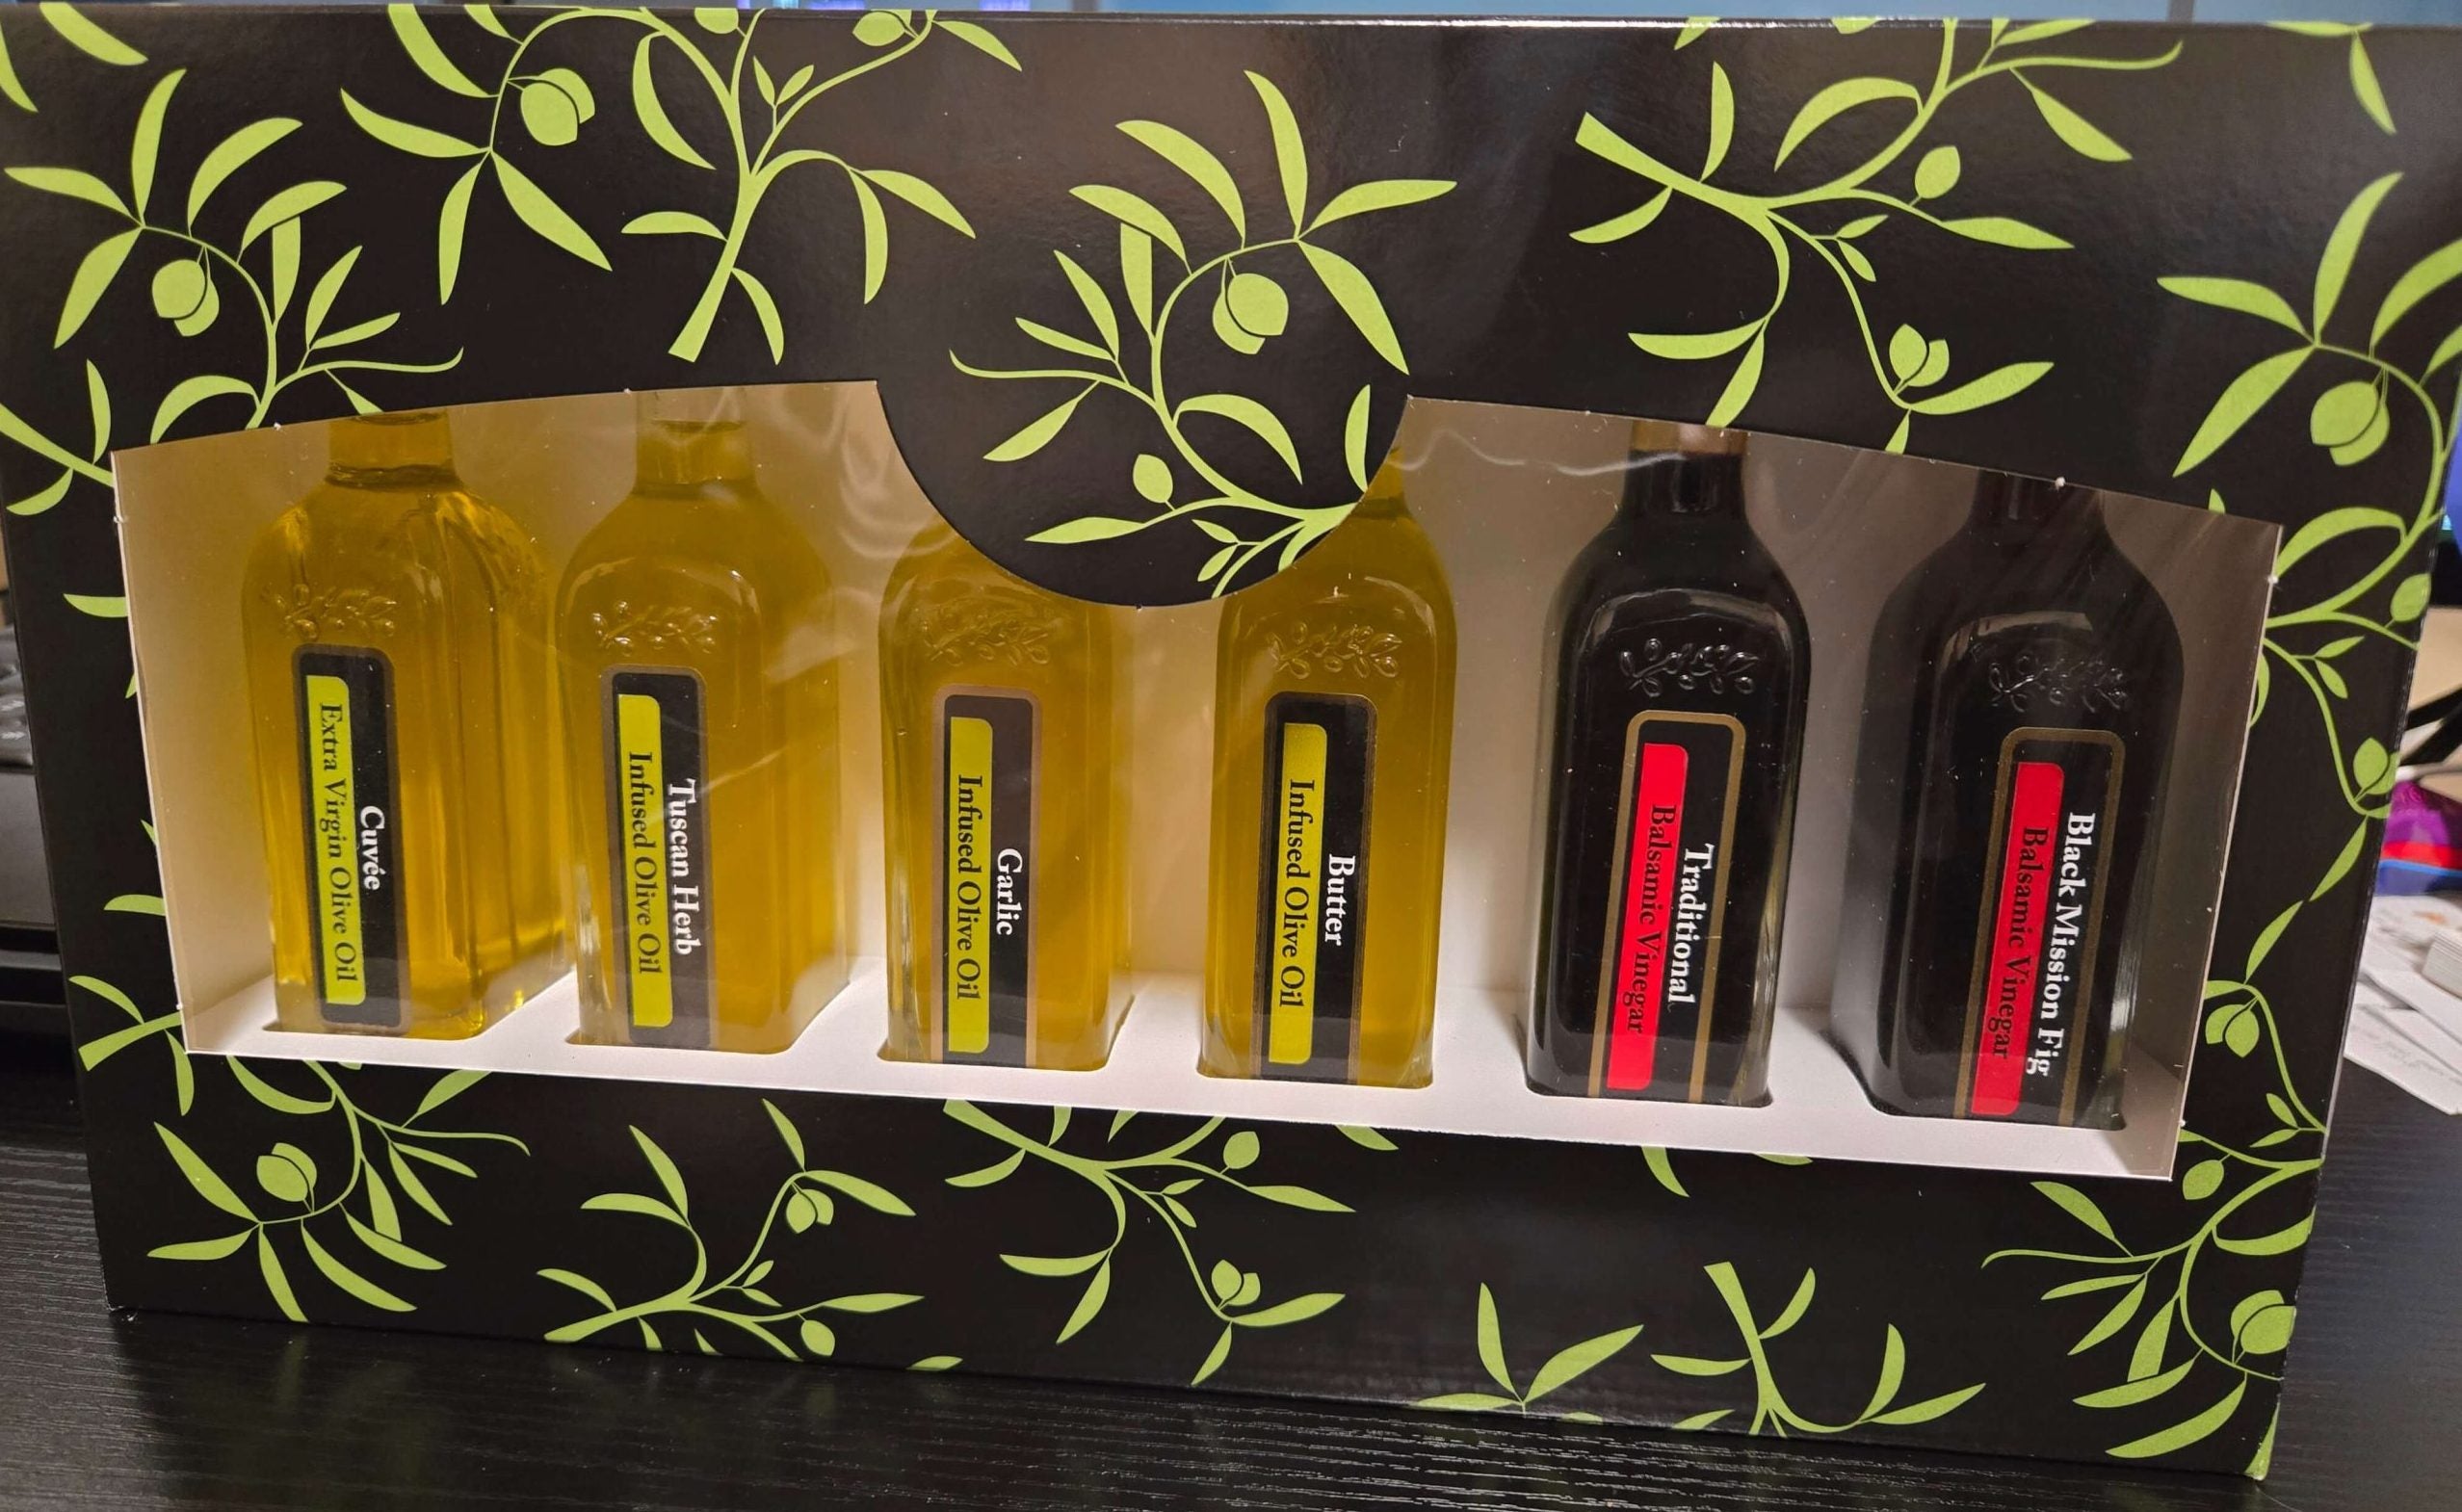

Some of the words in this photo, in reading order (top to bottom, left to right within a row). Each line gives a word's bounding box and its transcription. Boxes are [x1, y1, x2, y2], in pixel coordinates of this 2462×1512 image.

[319, 702, 344, 771] Extra
[319, 778, 348, 859] Virgin
[628, 751, 656, 849] Infused
[667, 778, 695, 878] Tuscan
[957, 774, 983, 874] Infused
[1286, 779, 1315, 878] Infused
[359, 805, 385, 891] Cuvée
[1639, 804, 1676, 925] Balsamic
[2009, 826, 2049, 951] Balsamic
[2058, 812, 2096, 897] Black
[329, 866, 353, 934] Olive
[633, 857, 658, 926] Olive
[672, 884, 702, 956] Herb
[956, 881, 982, 951] Olive
[996, 847, 1024, 935] Garlic
[1283, 886, 1310, 958] Olive
[1324, 853, 1356, 947] Butter
[1667, 842, 1716, 1005] Traditional
[335, 941, 357, 983] Oil
[637, 932, 662, 975] Oil
[956, 959, 982, 1002] Oil
[1279, 966, 1306, 1008] Oil
[1622, 931, 1663, 1034] Vinegar
[2040, 902, 2081, 1020] Mission
[1989, 954, 2032, 1059] Vinegar
[2026, 1026, 2065, 1077] Fig
